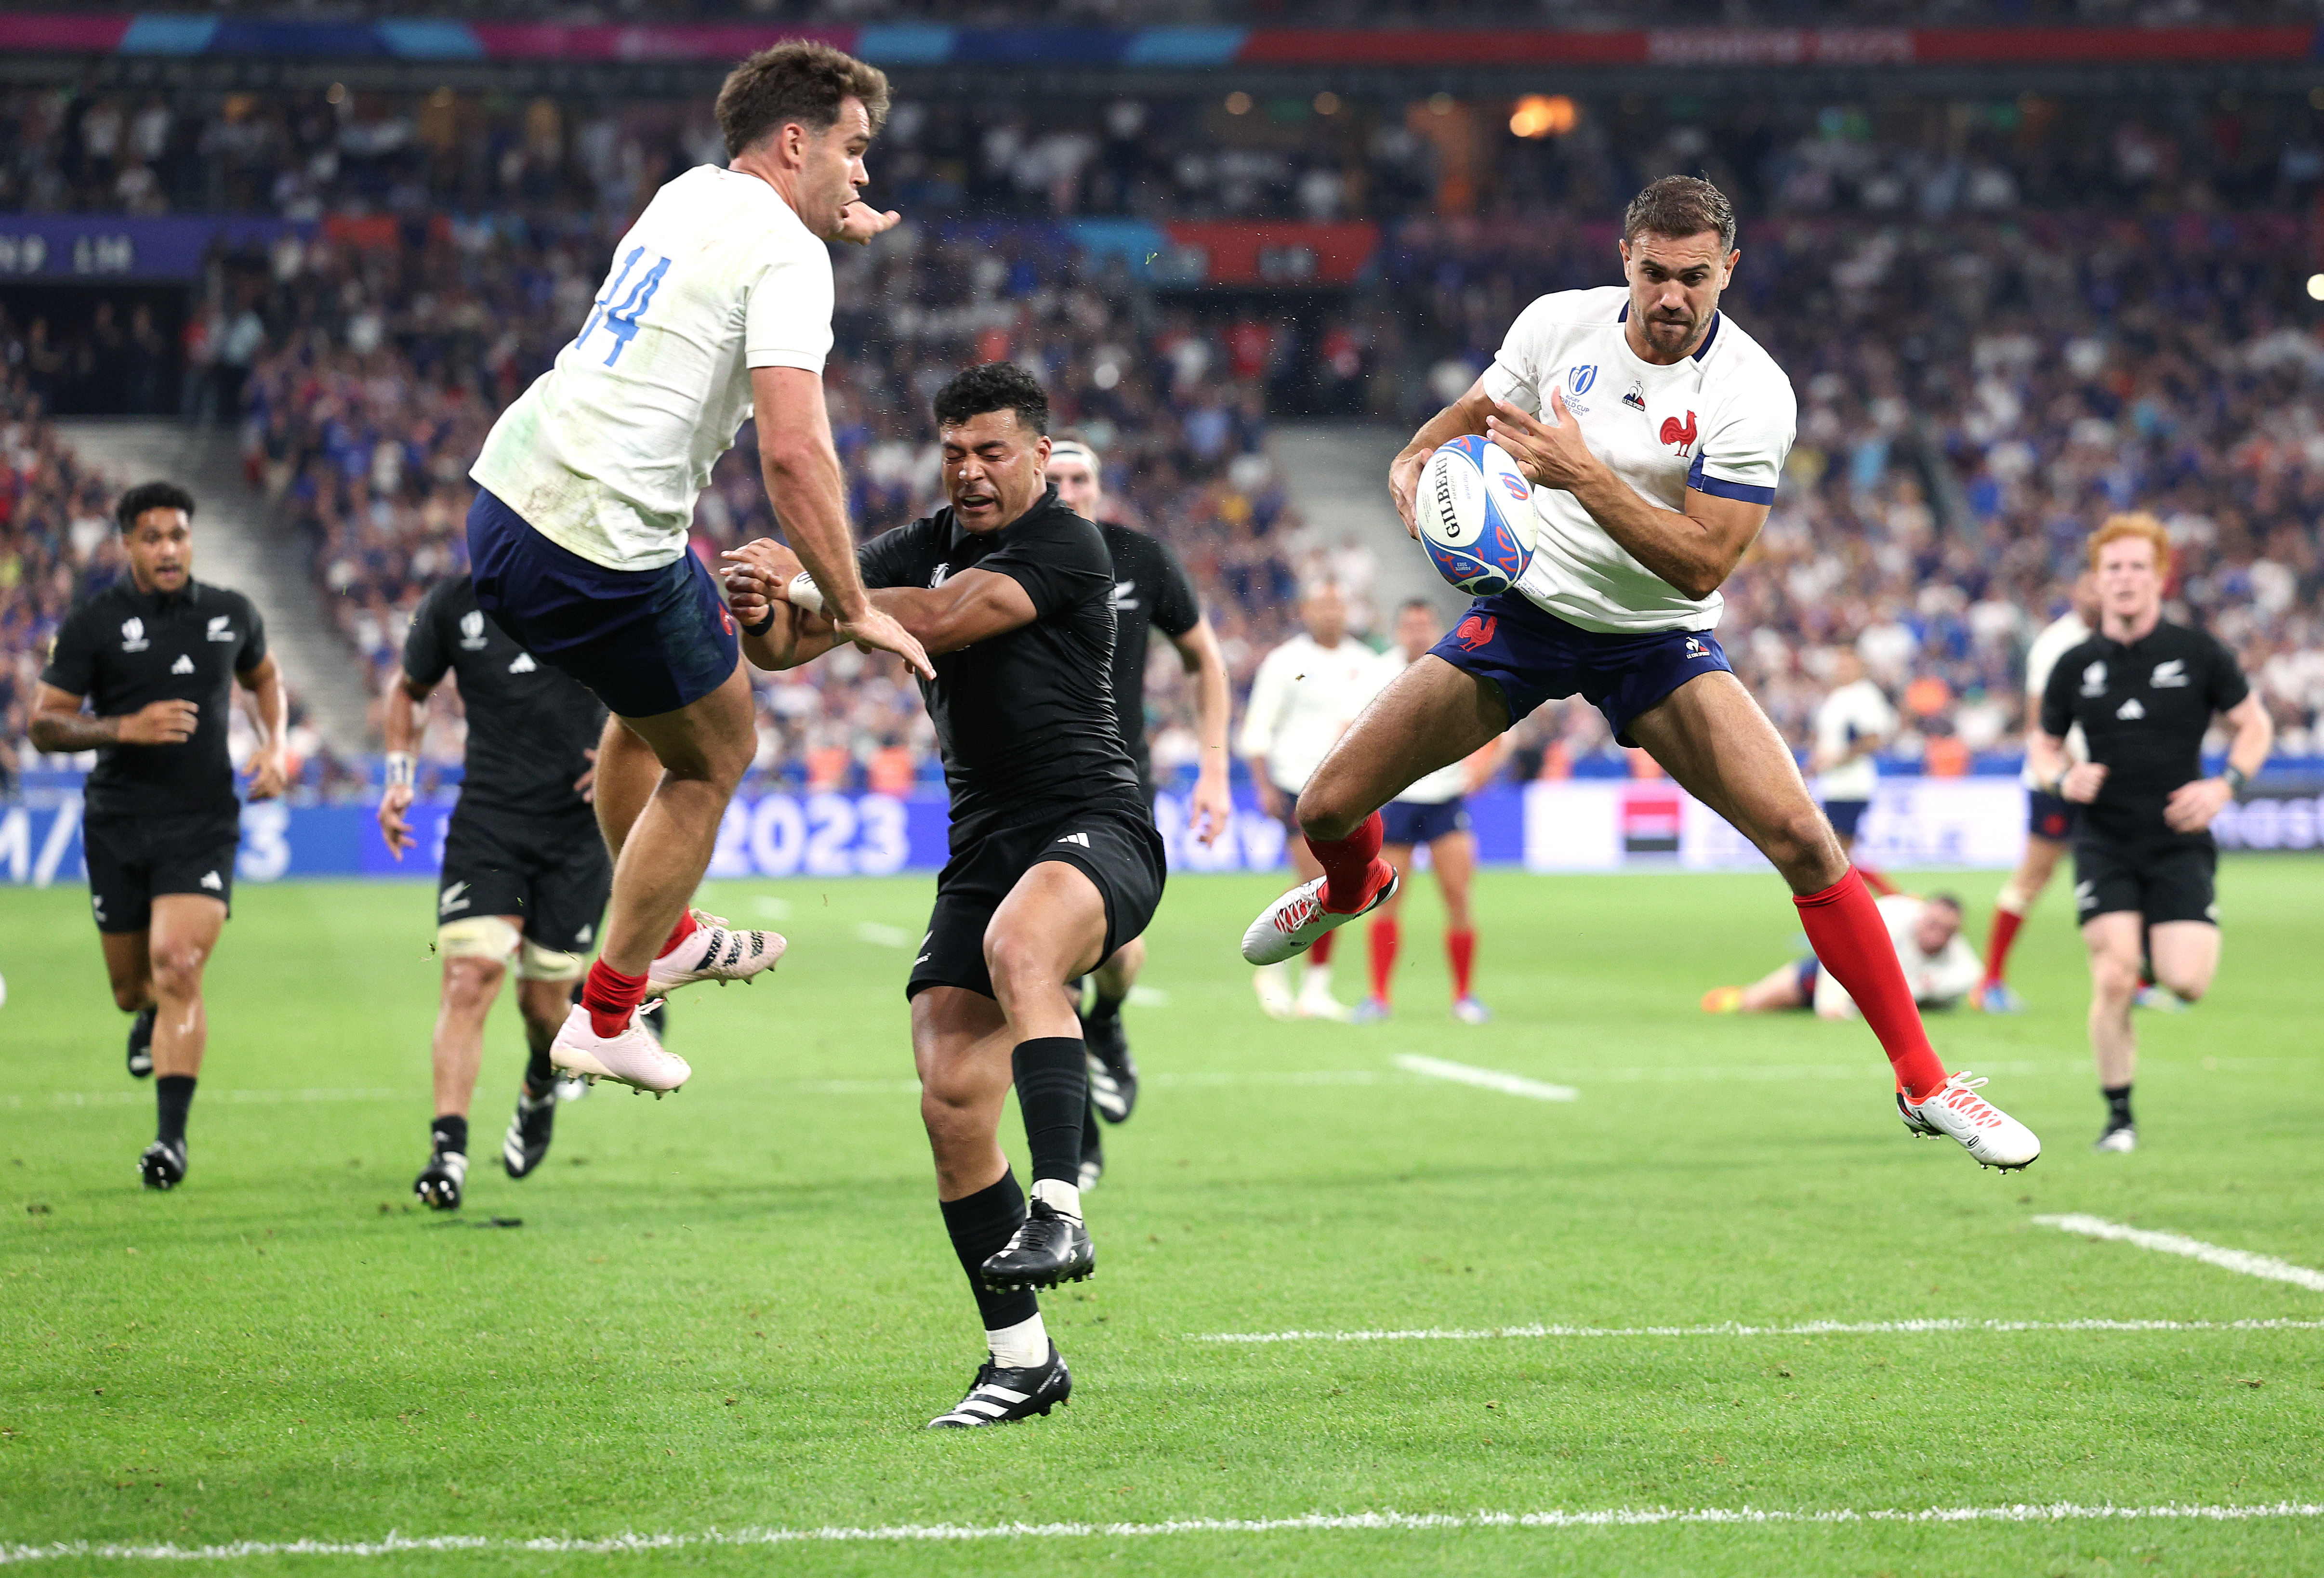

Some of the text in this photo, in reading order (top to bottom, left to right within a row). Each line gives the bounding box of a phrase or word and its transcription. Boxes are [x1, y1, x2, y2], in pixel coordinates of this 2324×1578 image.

[574, 246, 672, 367] 14
[1561, 397, 1576, 408] ORLD
[1577, 405, 1590, 413] CUP
[1565, 394, 1580, 403] RUGBY
[1435, 456, 1461, 538] GILBERT
[705, 793, 911, 877] 2023
